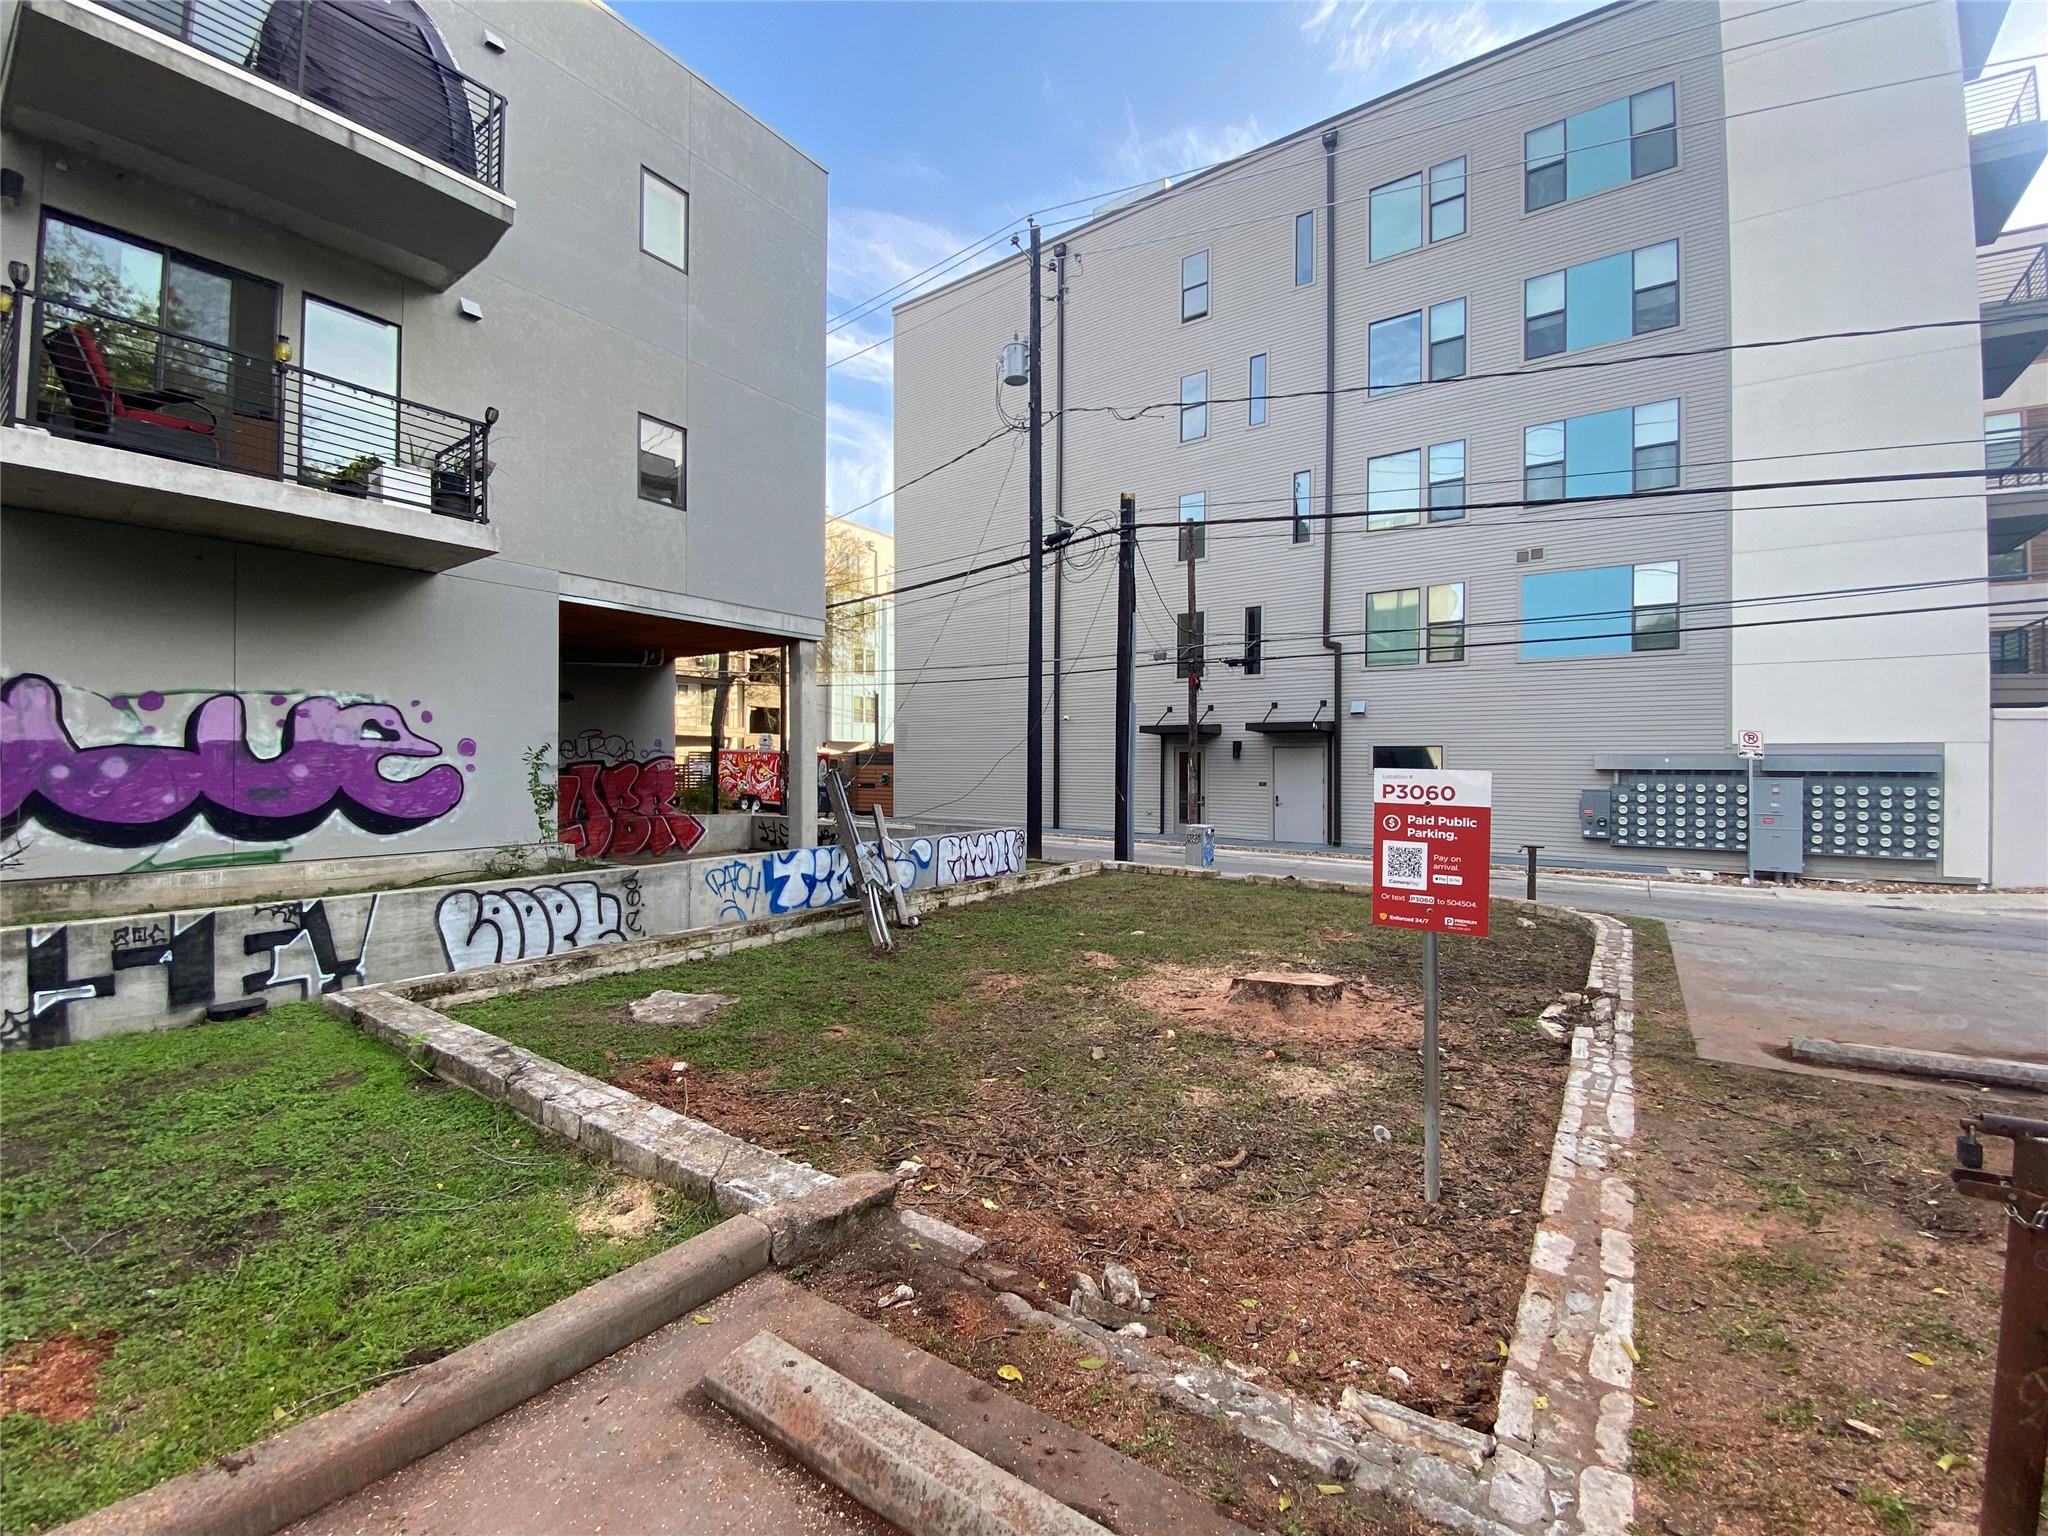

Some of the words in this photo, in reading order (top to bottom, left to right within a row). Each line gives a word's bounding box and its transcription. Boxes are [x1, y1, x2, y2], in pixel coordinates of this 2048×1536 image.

[1382, 784, 1456, 801] P3060
[1407, 815, 1434, 825] Paid
[1438, 816, 1477, 828] Public
[1407, 828, 1458, 841] Parking.
[1433, 854, 1448, 863] Pay
[1433, 863, 1459, 871] arrival.
[1410, 896, 1434, 904] P3060
[1446, 900, 1478, 908] 504504.
[1389, 915, 1414, 923] Enforced
